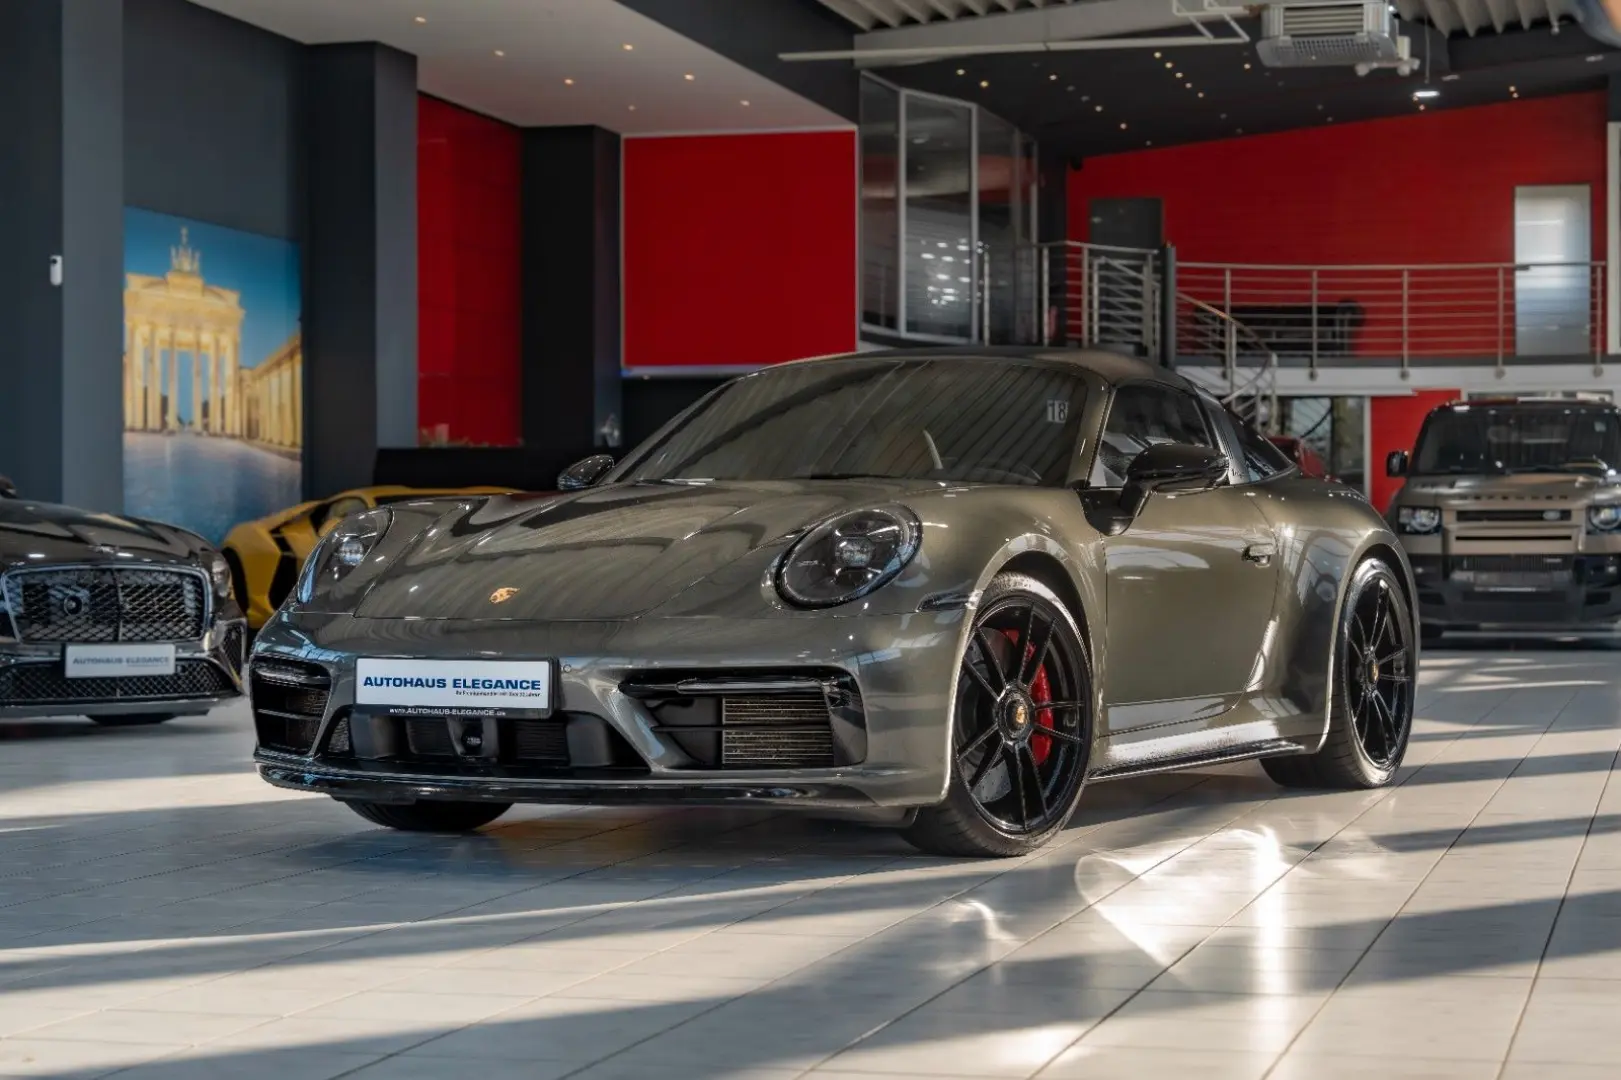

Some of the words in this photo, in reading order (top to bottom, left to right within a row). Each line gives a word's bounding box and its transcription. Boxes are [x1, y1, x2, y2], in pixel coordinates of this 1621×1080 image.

[1048, 401, 1067, 421] 18
[363, 676, 447, 689] AUTOHAUS
[452, 678, 541, 690] ELEGANCE
